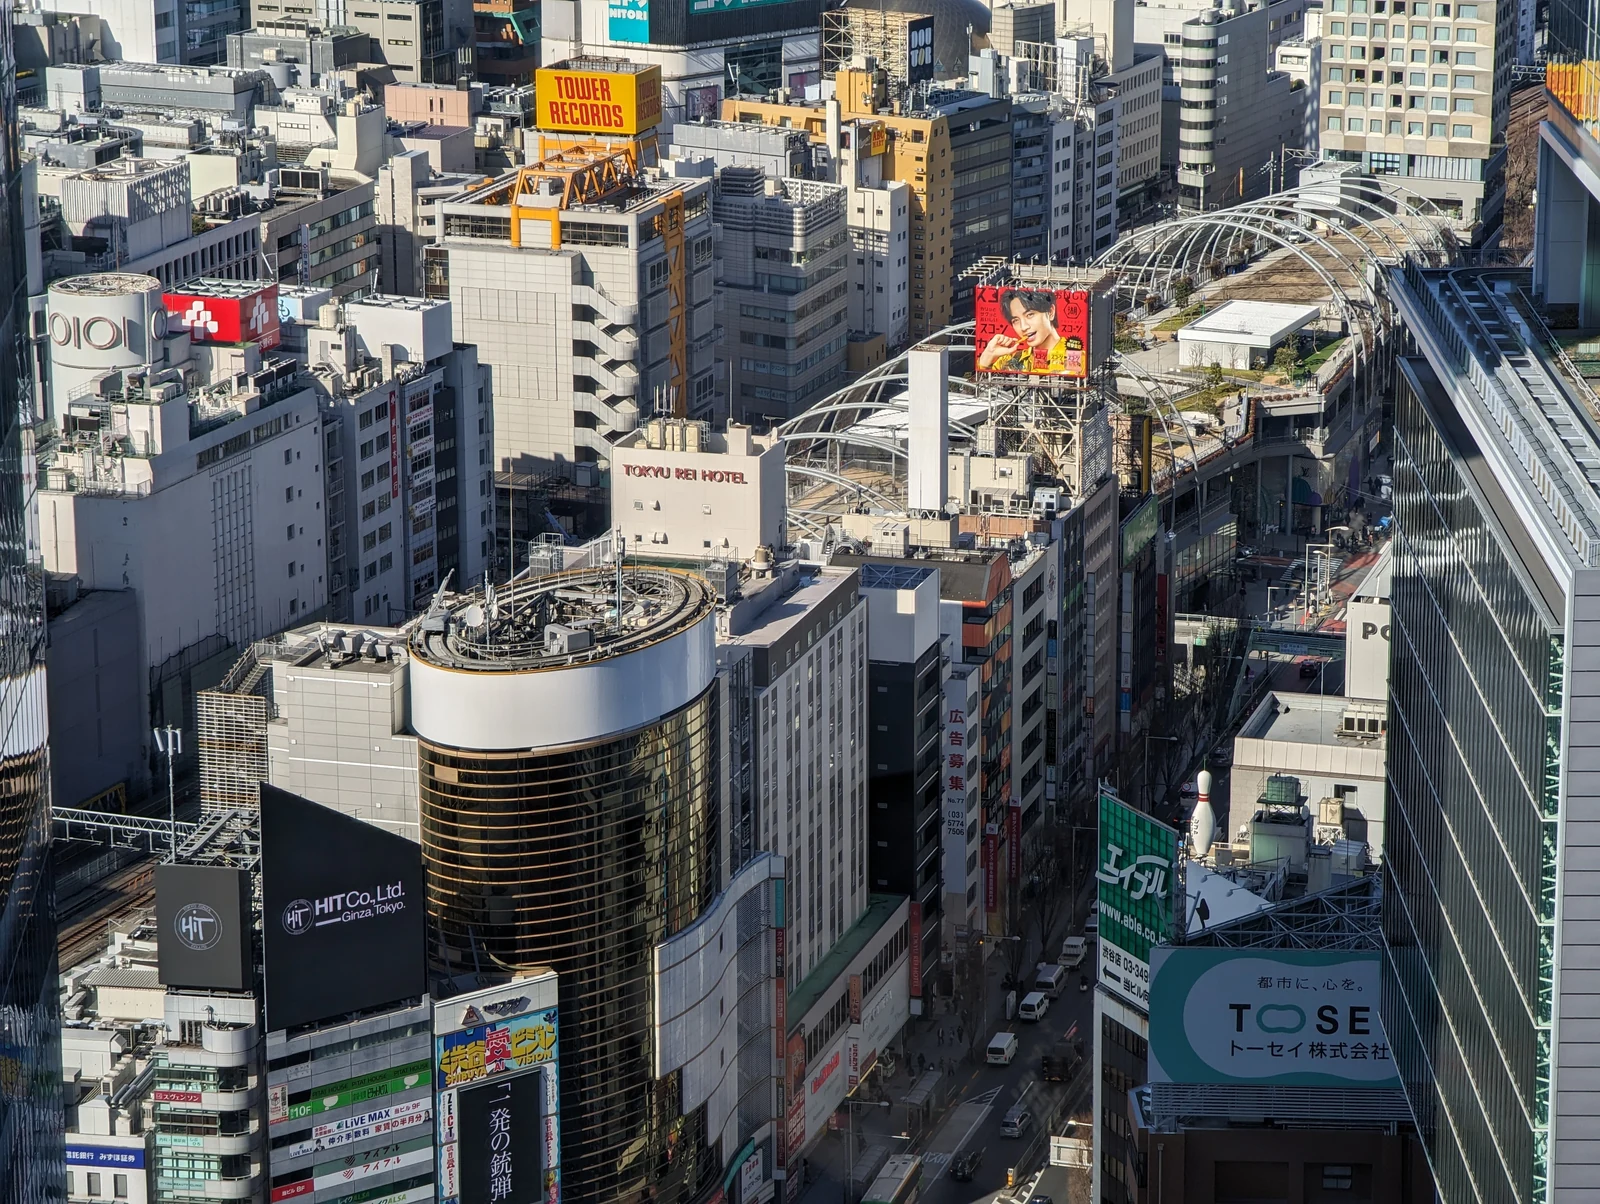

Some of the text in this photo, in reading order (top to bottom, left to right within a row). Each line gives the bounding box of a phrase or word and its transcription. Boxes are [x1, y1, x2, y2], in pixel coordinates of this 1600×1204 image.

[609, 8, 648, 21] NITORI
[554, 76, 612, 102] TOWER
[638, 79, 657, 100] TOWER
[549, 101, 624, 128] RECORDS
[637, 96, 660, 121] RECORDS
[873, 129, 885, 142] ABC
[980, 323, 1008, 334] スコーン
[1061, 325, 1083, 333] スコーン
[622, 464, 748, 485] TOKYU REI HOTEL
[949, 709, 965, 791] 広告募集
[948, 811, 964, 819] (03)
[948, 819, 965, 828] 5774
[948, 827, 965, 836] 7506
[1095, 842, 1169, 900] エイブル
[315, 894, 345, 916] HIT
[1102, 944, 1122, 967] 渋谷店
[1257, 976, 1364, 992] 都市に、心を。
[1231, 1039, 1390, 1061] トーセイ株式会社
[409, 1063, 428, 1072] HOUSE
[445, 1050, 553, 1085] SHIBUYA AI VISION
[368, 1074, 388, 1084] HOUSE
[163, 1093, 200, 1102] スヴェンソン
[328, 1085, 348, 1094] HOUSE
[294, 1105, 311, 1118] 10F
[368, 1109, 390, 1123] MAX
[394, 1105, 411, 1115] 当ビル
[412, 1102, 420, 1110] 9F
[328, 1128, 370, 1146] 仲介手数料
[375, 1114, 422, 1132] 家賃の半月分
[489, 1083, 512, 1204] 「一発の銃弾
[99, 1153, 135, 1162] みずほ証券
[364, 1144, 400, 1161] アイフル
[363, 1156, 401, 1173] アイフル
[296, 1185, 305, 1193] 8F
[407, 1180, 419, 1189] 7F
